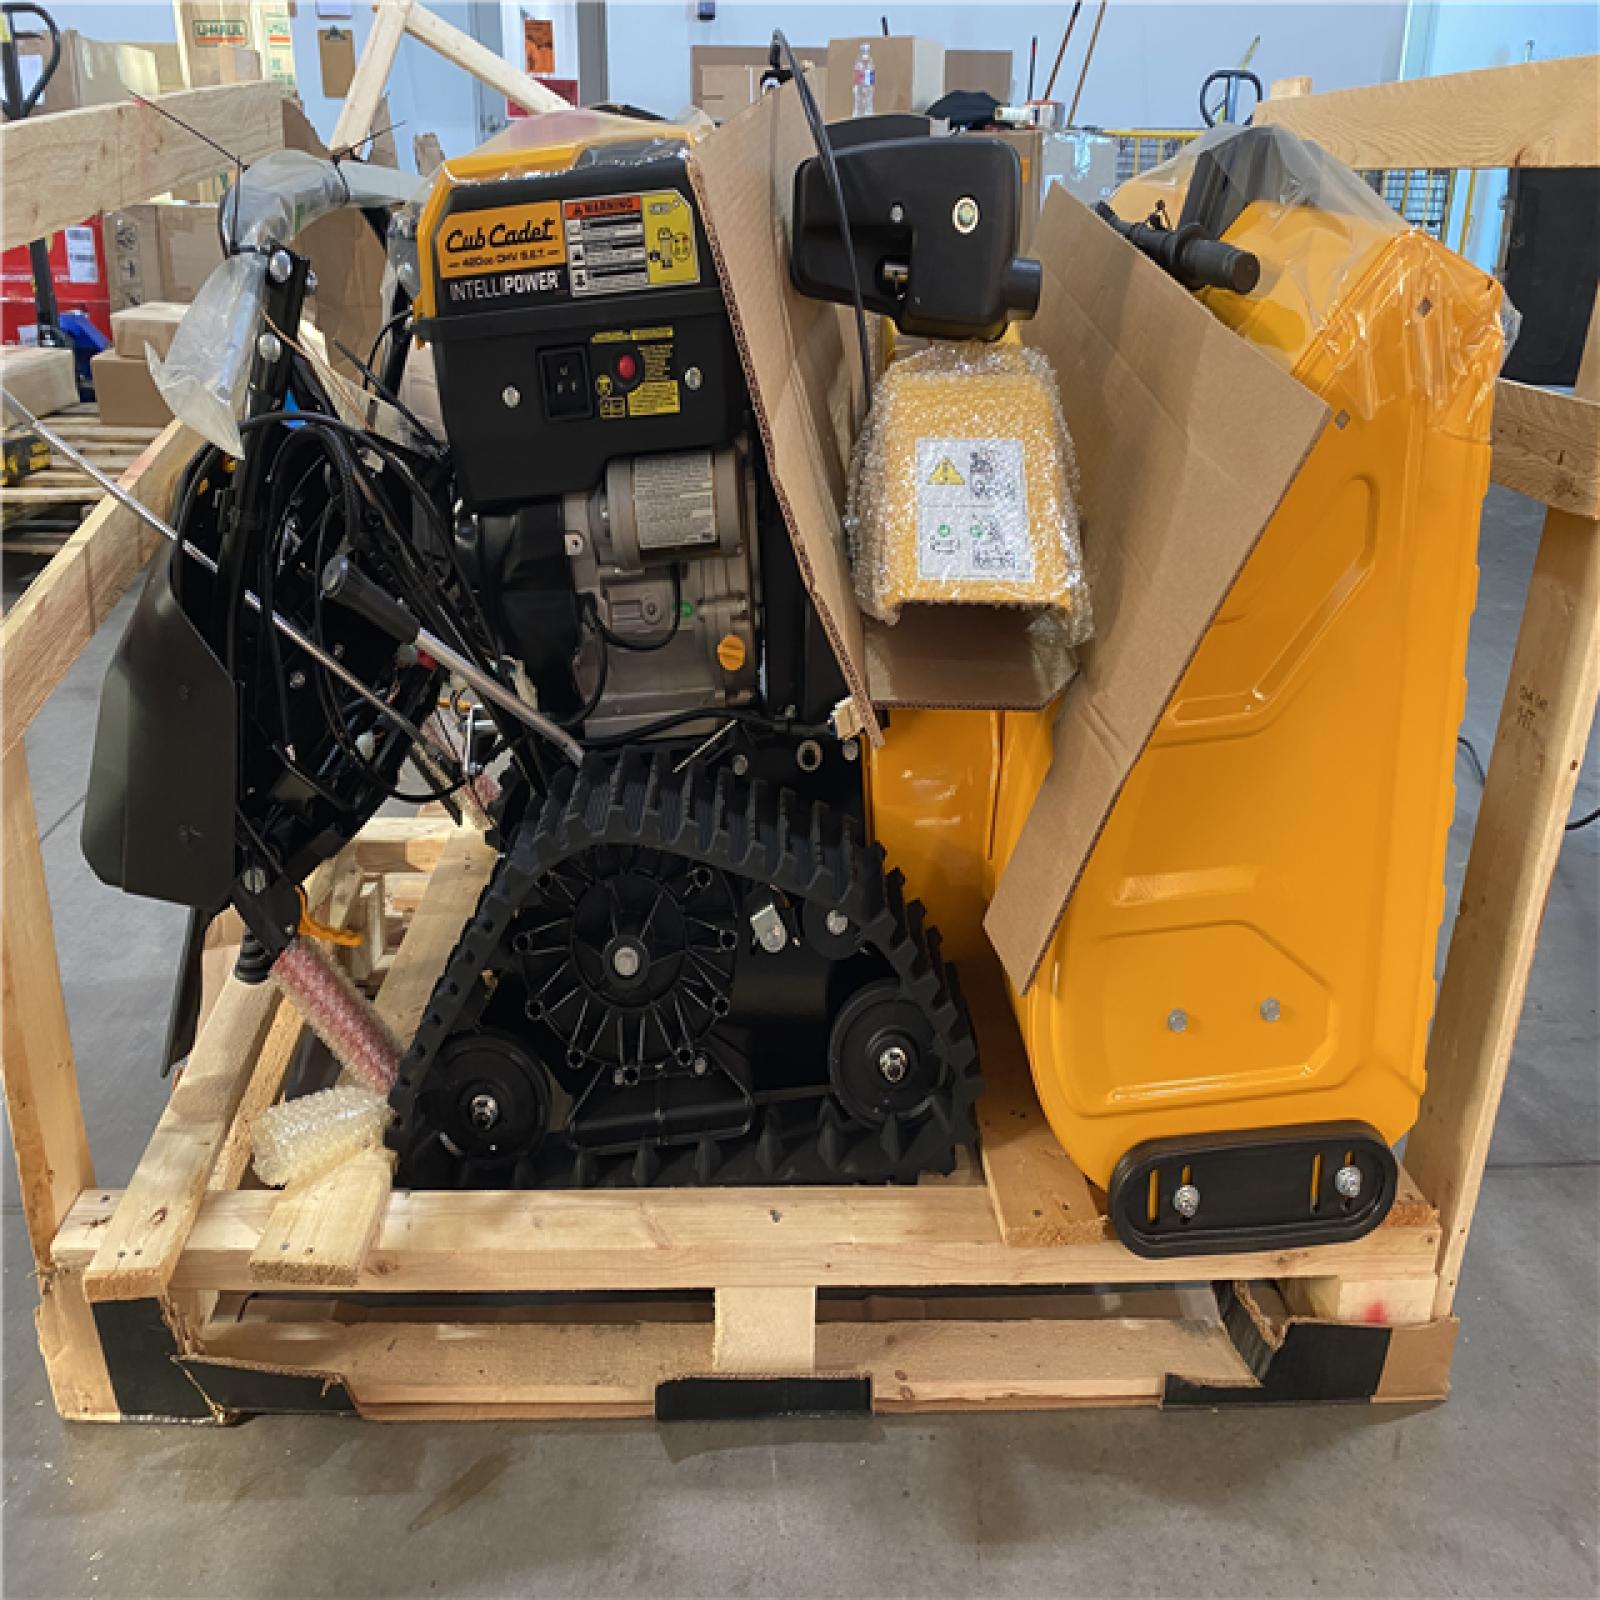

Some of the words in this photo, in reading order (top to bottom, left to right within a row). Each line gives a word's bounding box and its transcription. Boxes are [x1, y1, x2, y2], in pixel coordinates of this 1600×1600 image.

[445, 227, 486, 253] Cub
[489, 217, 556, 248] Cadet
[449, 270, 559, 300] INTELLIPOWER
